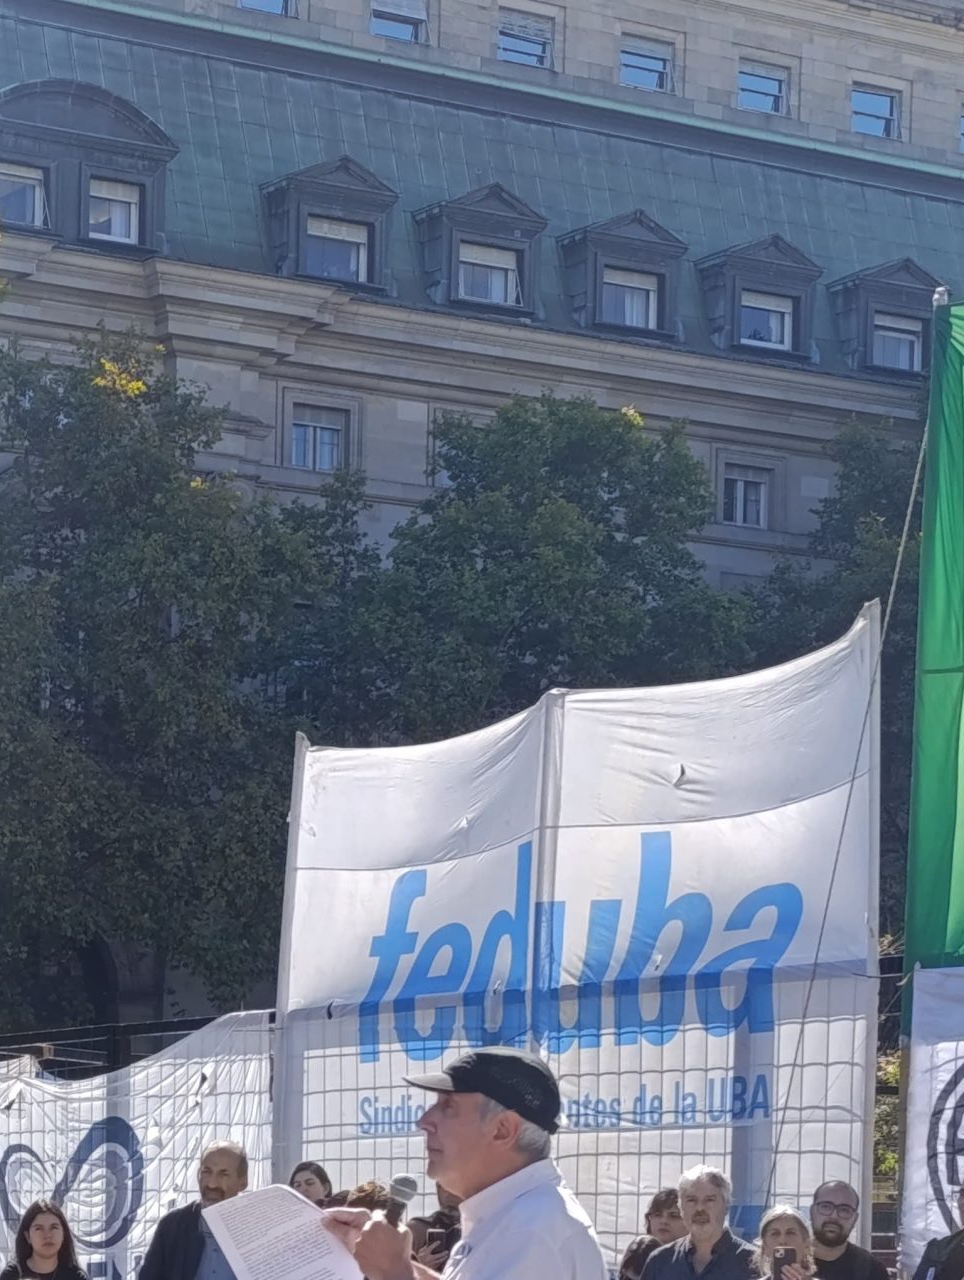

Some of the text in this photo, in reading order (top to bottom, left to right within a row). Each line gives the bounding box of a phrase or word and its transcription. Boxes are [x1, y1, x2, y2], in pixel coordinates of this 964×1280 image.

[359, 831, 803, 1063] feduba
[360, 1095, 425, 1134] Sindic
[561, 1092, 620, 1128] ntes
[633, 1084, 662, 1126] de
[674, 1081, 697, 1124] la
[708, 1074, 770, 1122] UBA
